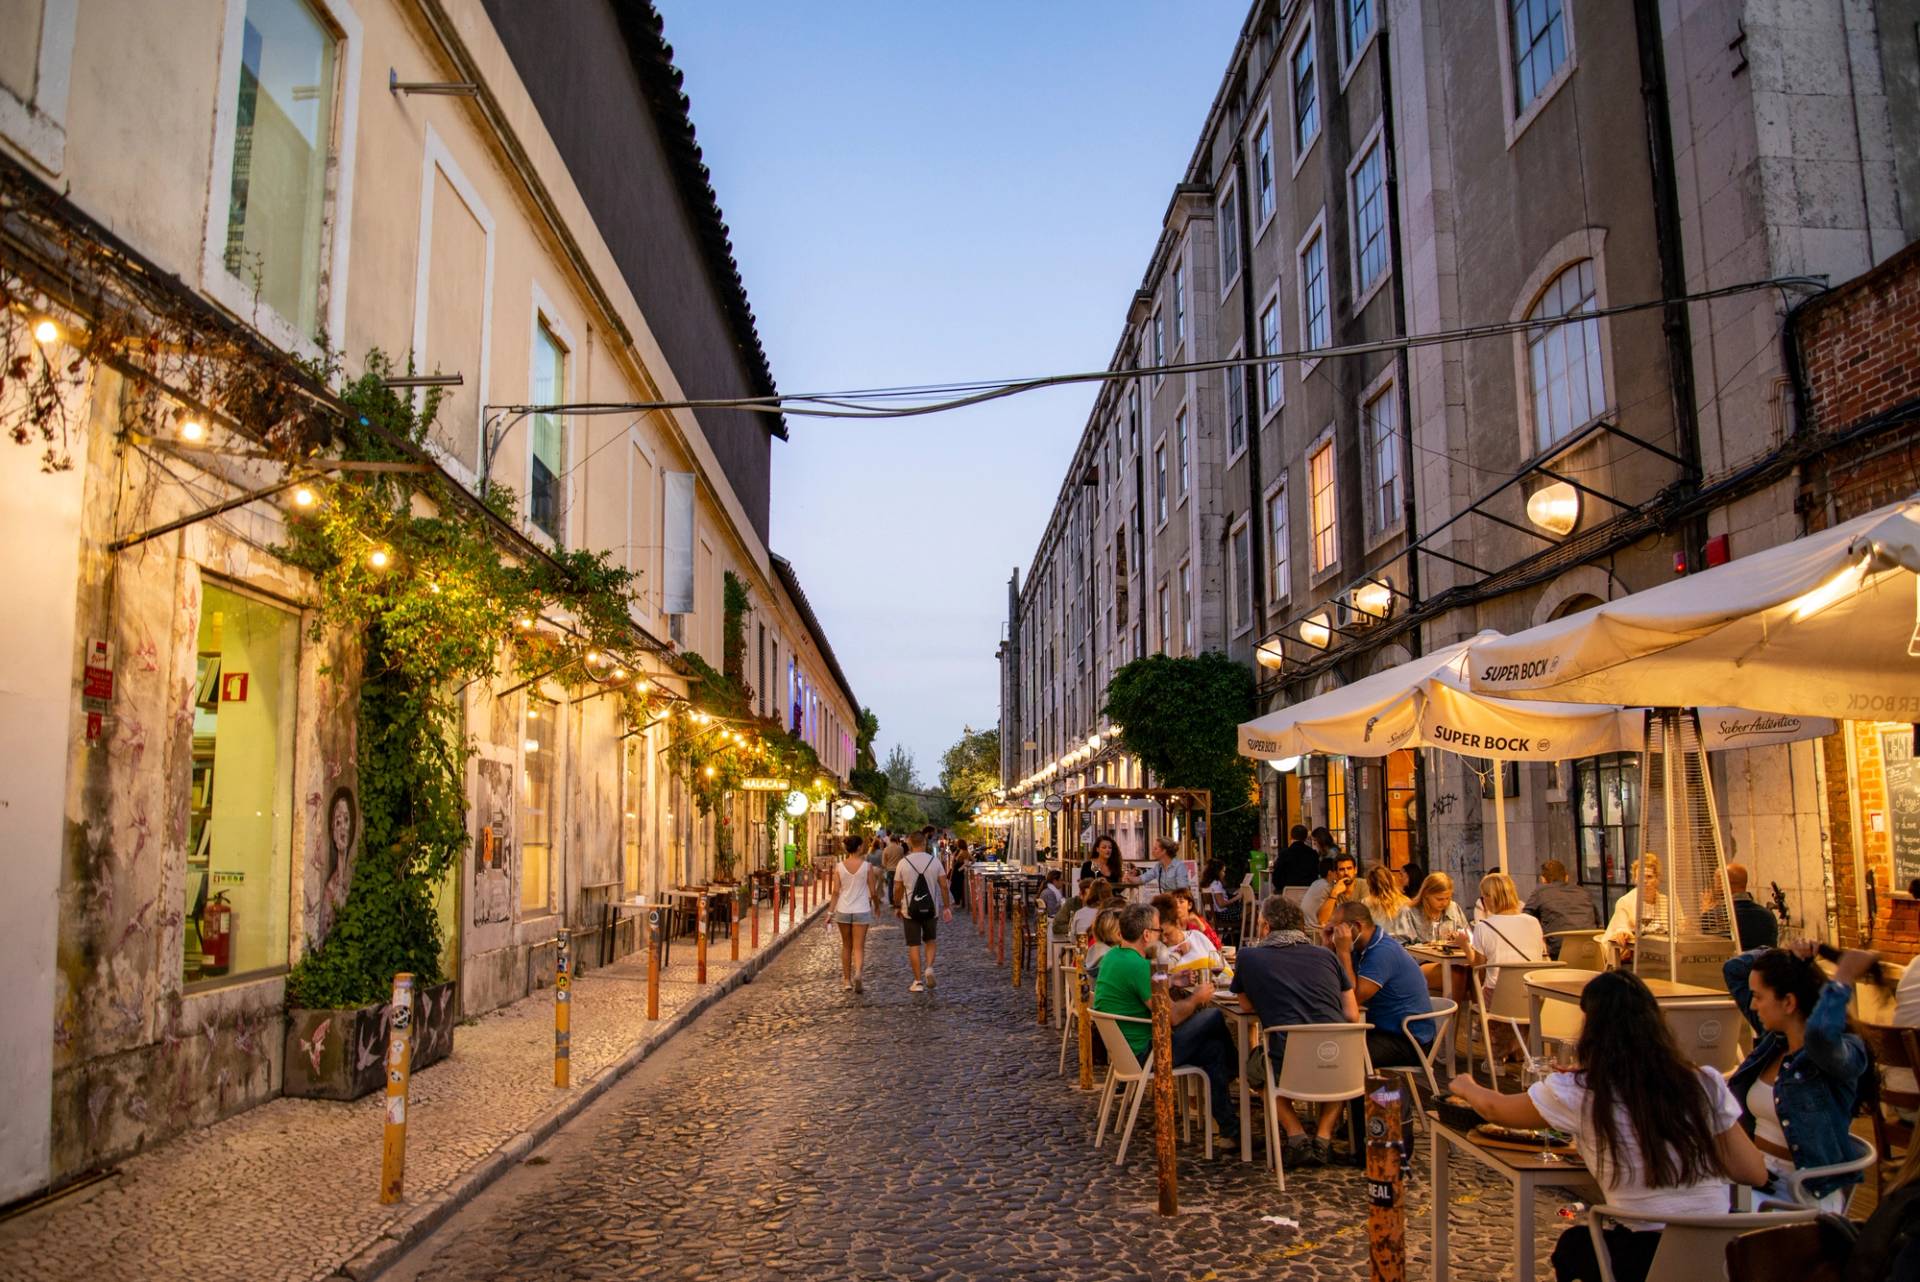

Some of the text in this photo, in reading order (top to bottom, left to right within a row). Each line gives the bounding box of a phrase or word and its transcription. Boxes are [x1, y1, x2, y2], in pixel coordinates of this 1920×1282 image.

[1481, 658, 1549, 682] SUPER BOCK
[1717, 718, 1750, 735] Sabor
[1434, 725, 1481, 748] SUPER
[1484, 736, 1530, 752] BOCK
[1368, 1182, 1392, 1200] REAL
